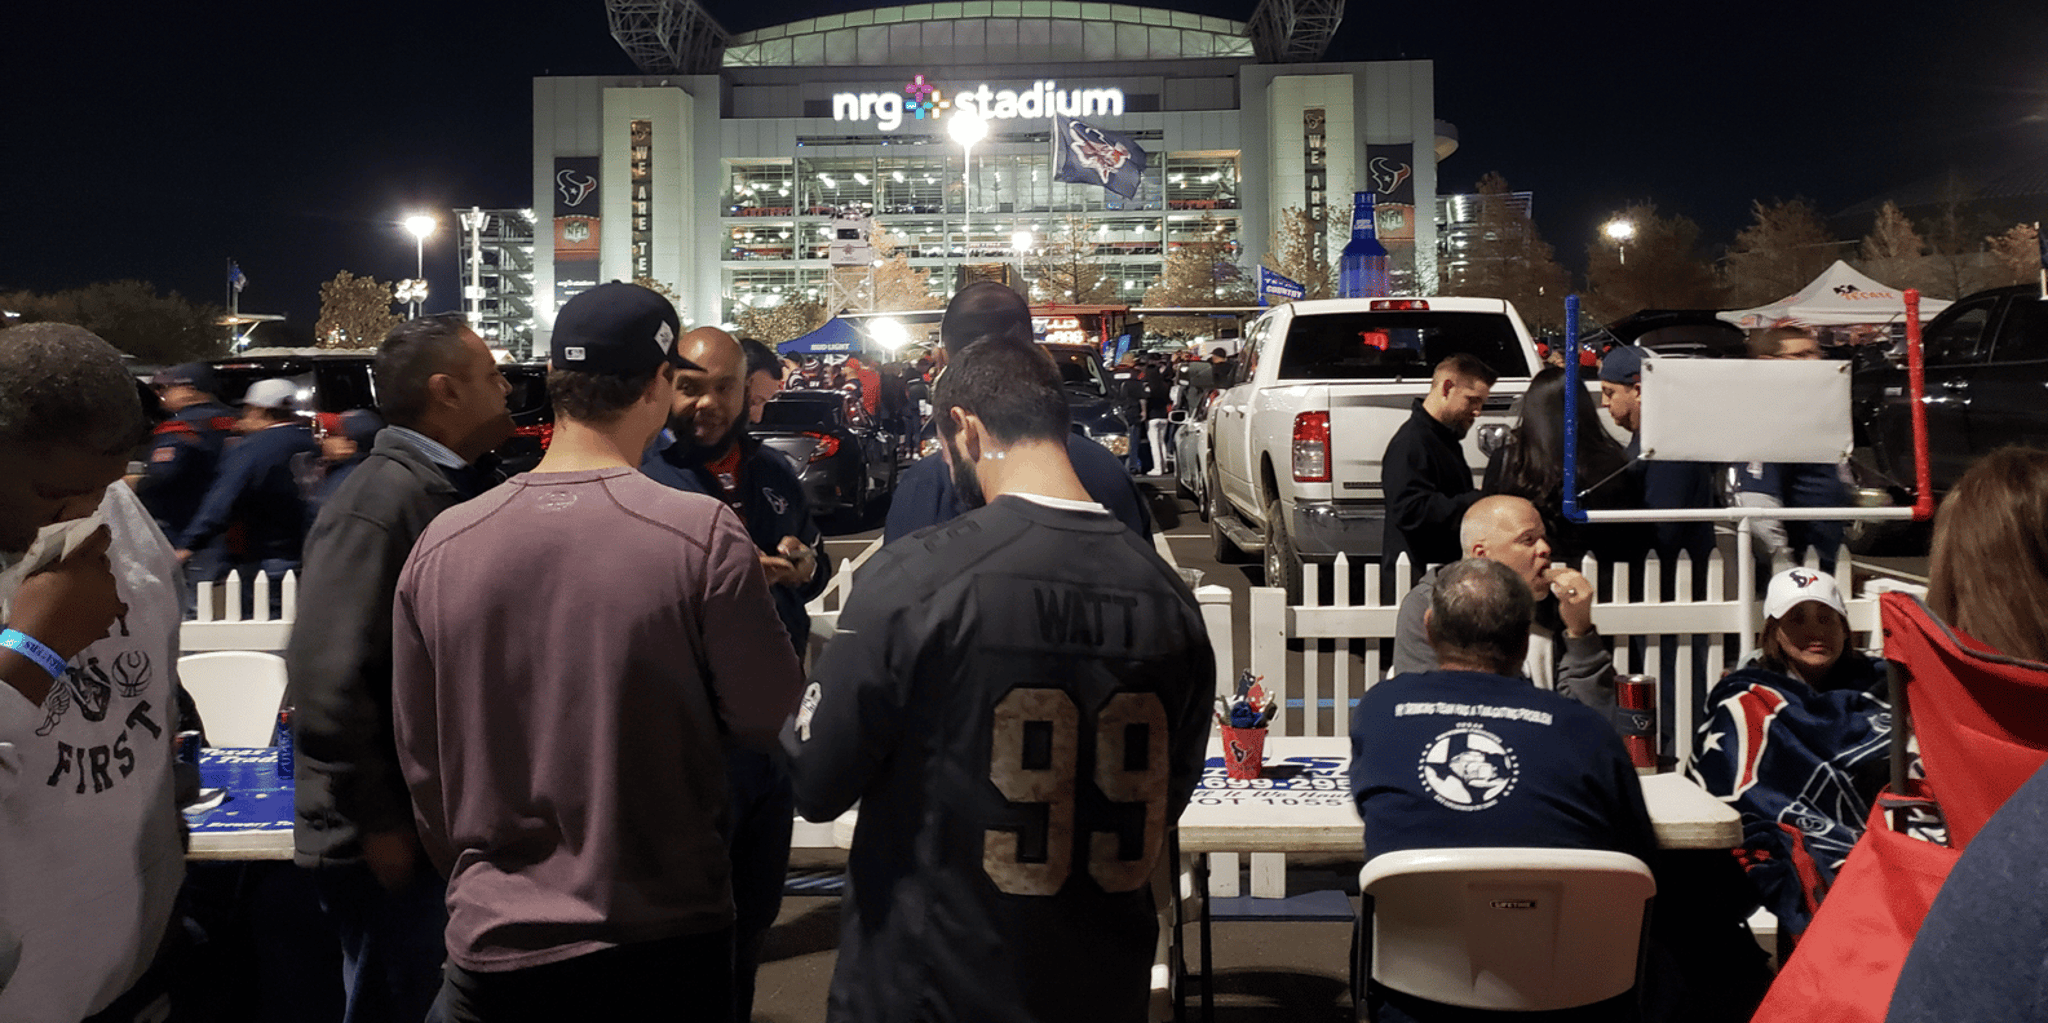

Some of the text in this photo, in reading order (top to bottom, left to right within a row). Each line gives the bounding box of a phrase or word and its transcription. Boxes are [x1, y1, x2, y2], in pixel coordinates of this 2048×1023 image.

[833, 79, 1124, 131] nrg stadium
[1309, 134, 1321, 165] WE
[636, 146, 648, 276] WE ARE TE
[1311, 175, 1320, 221] ARE
[566, 225, 589, 238] NFL
[1034, 588, 1138, 648] WATT
[47, 700, 162, 794] FIRST
[982, 687, 1170, 896] 99
